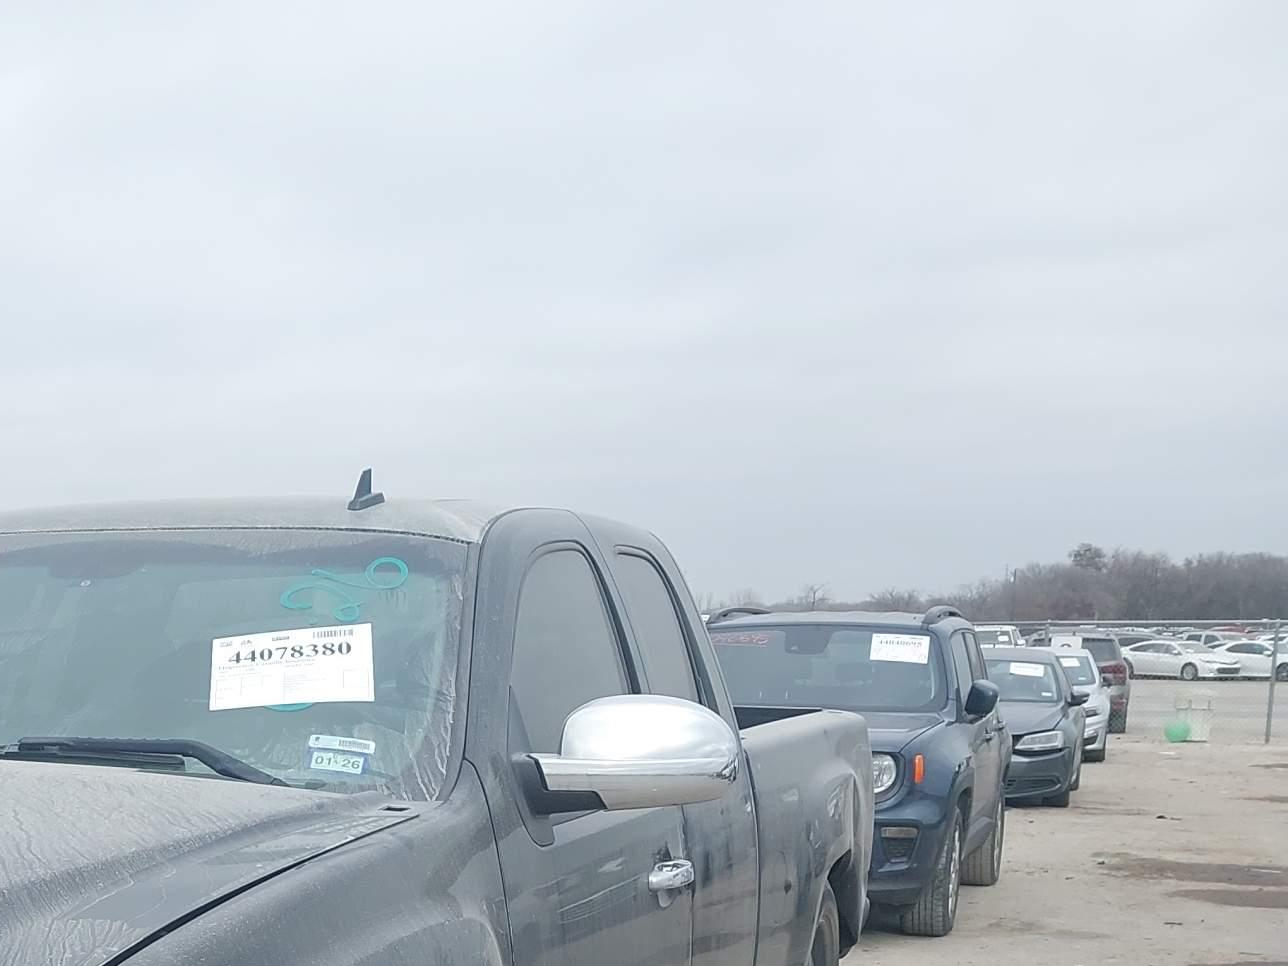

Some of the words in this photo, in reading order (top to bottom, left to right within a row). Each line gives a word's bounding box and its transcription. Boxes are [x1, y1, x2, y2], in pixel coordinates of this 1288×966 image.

[228, 641, 352, 664] 44078380
[314, 755, 333, 766] 01
[341, 758, 361, 770] 26
